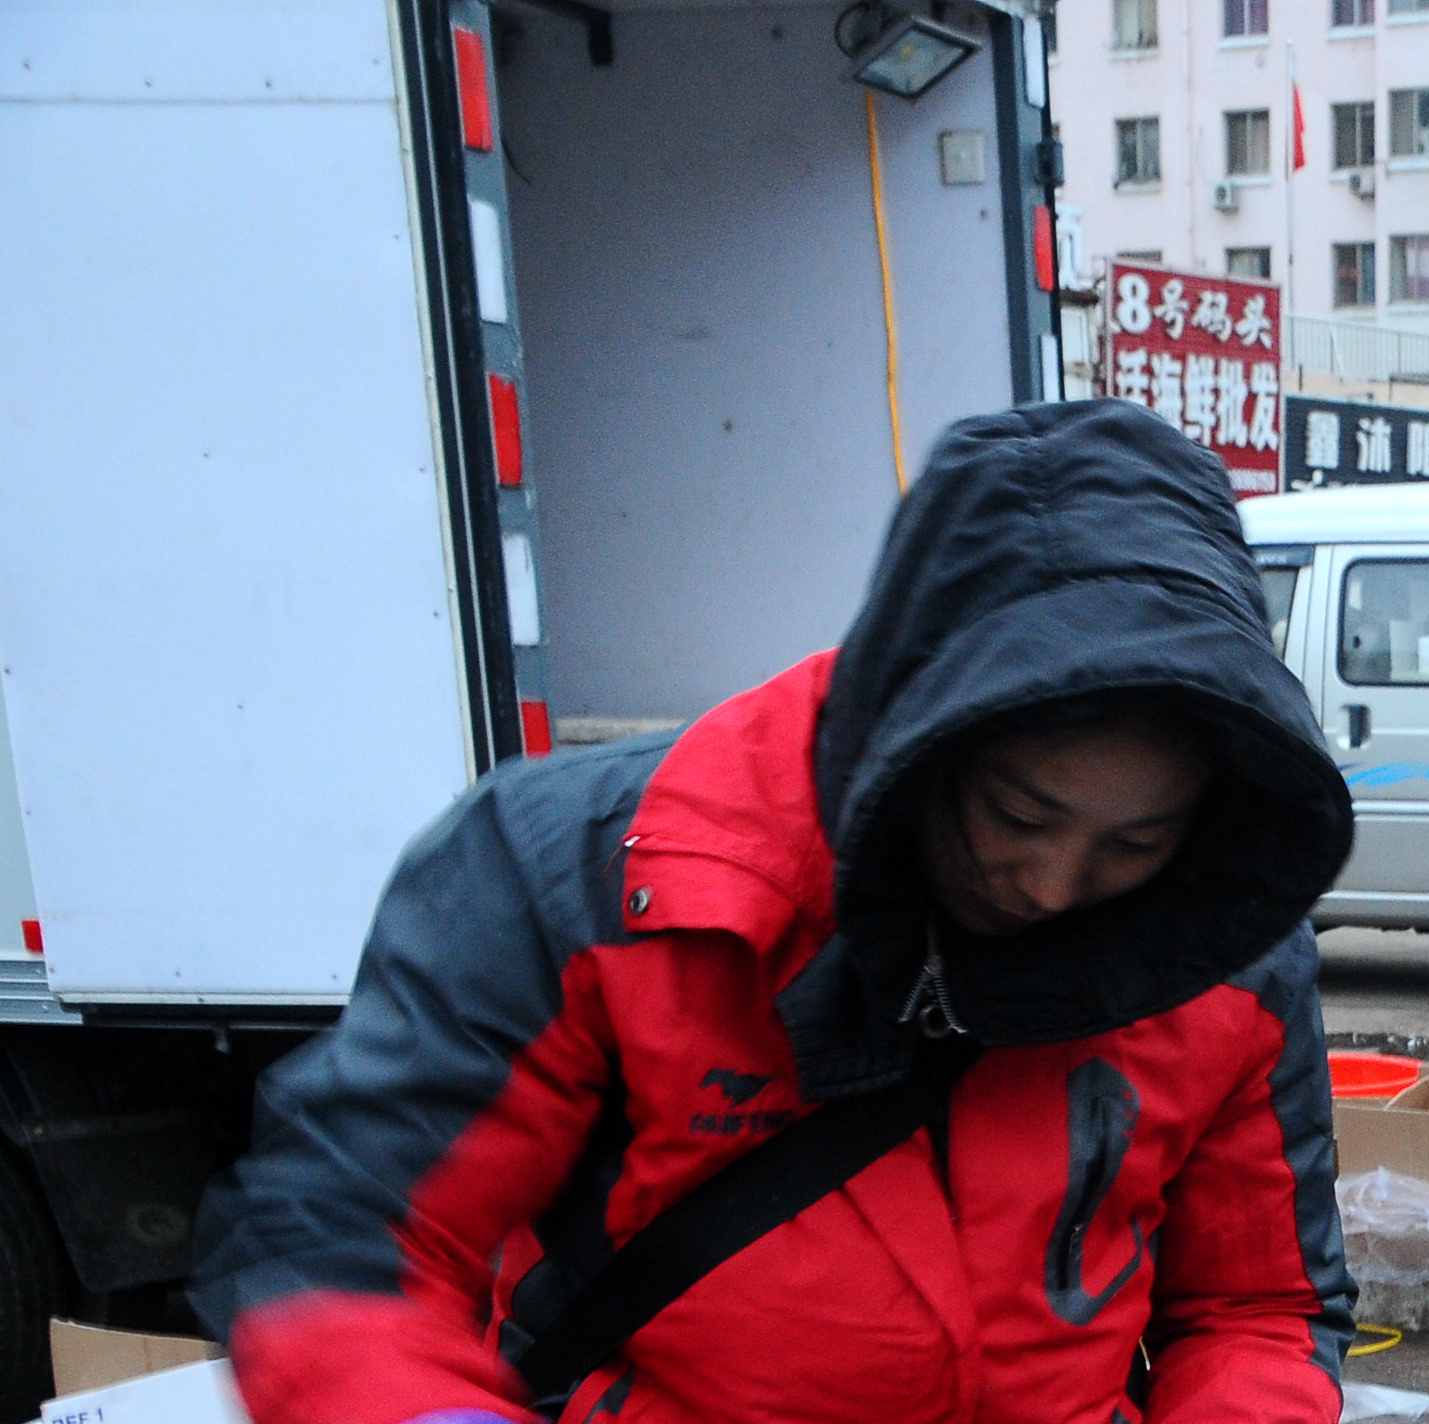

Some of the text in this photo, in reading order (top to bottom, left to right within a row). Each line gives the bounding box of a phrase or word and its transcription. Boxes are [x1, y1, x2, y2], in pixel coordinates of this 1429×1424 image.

[1116, 273, 1273, 349] 8号码头
[1115, 347, 1279, 450] 活海鲜批发
